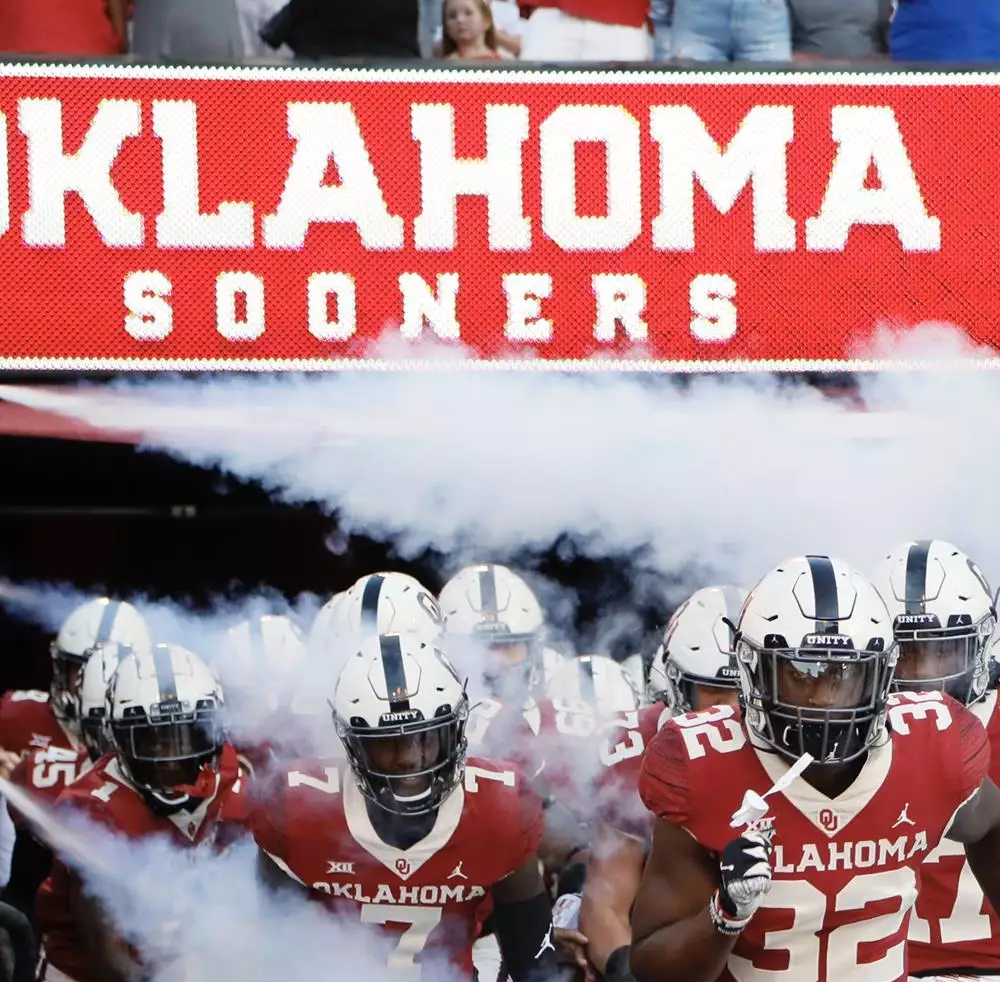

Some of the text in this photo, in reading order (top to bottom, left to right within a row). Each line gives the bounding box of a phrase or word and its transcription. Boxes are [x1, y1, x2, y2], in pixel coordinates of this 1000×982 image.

[0, 97, 941, 253] KLAHOMA
[123, 269, 738, 343] SOONERS
[897, 614, 935, 624] UNITY
[806, 635, 851, 646] UNITY
[382, 710, 419, 723] UNITY
[671, 704, 747, 760] 32
[32, 745, 79, 789] 45
[287, 766, 341, 794] 7
[464, 765, 516, 794] 7
[820, 808, 838, 831] OU
[773, 830, 928, 873] LAHOMA
[325, 860, 357, 876] XII
[394, 858, 411, 876] OU
[312, 881, 486, 904] OKLAHOMA
[360, 903, 443, 970] 7
